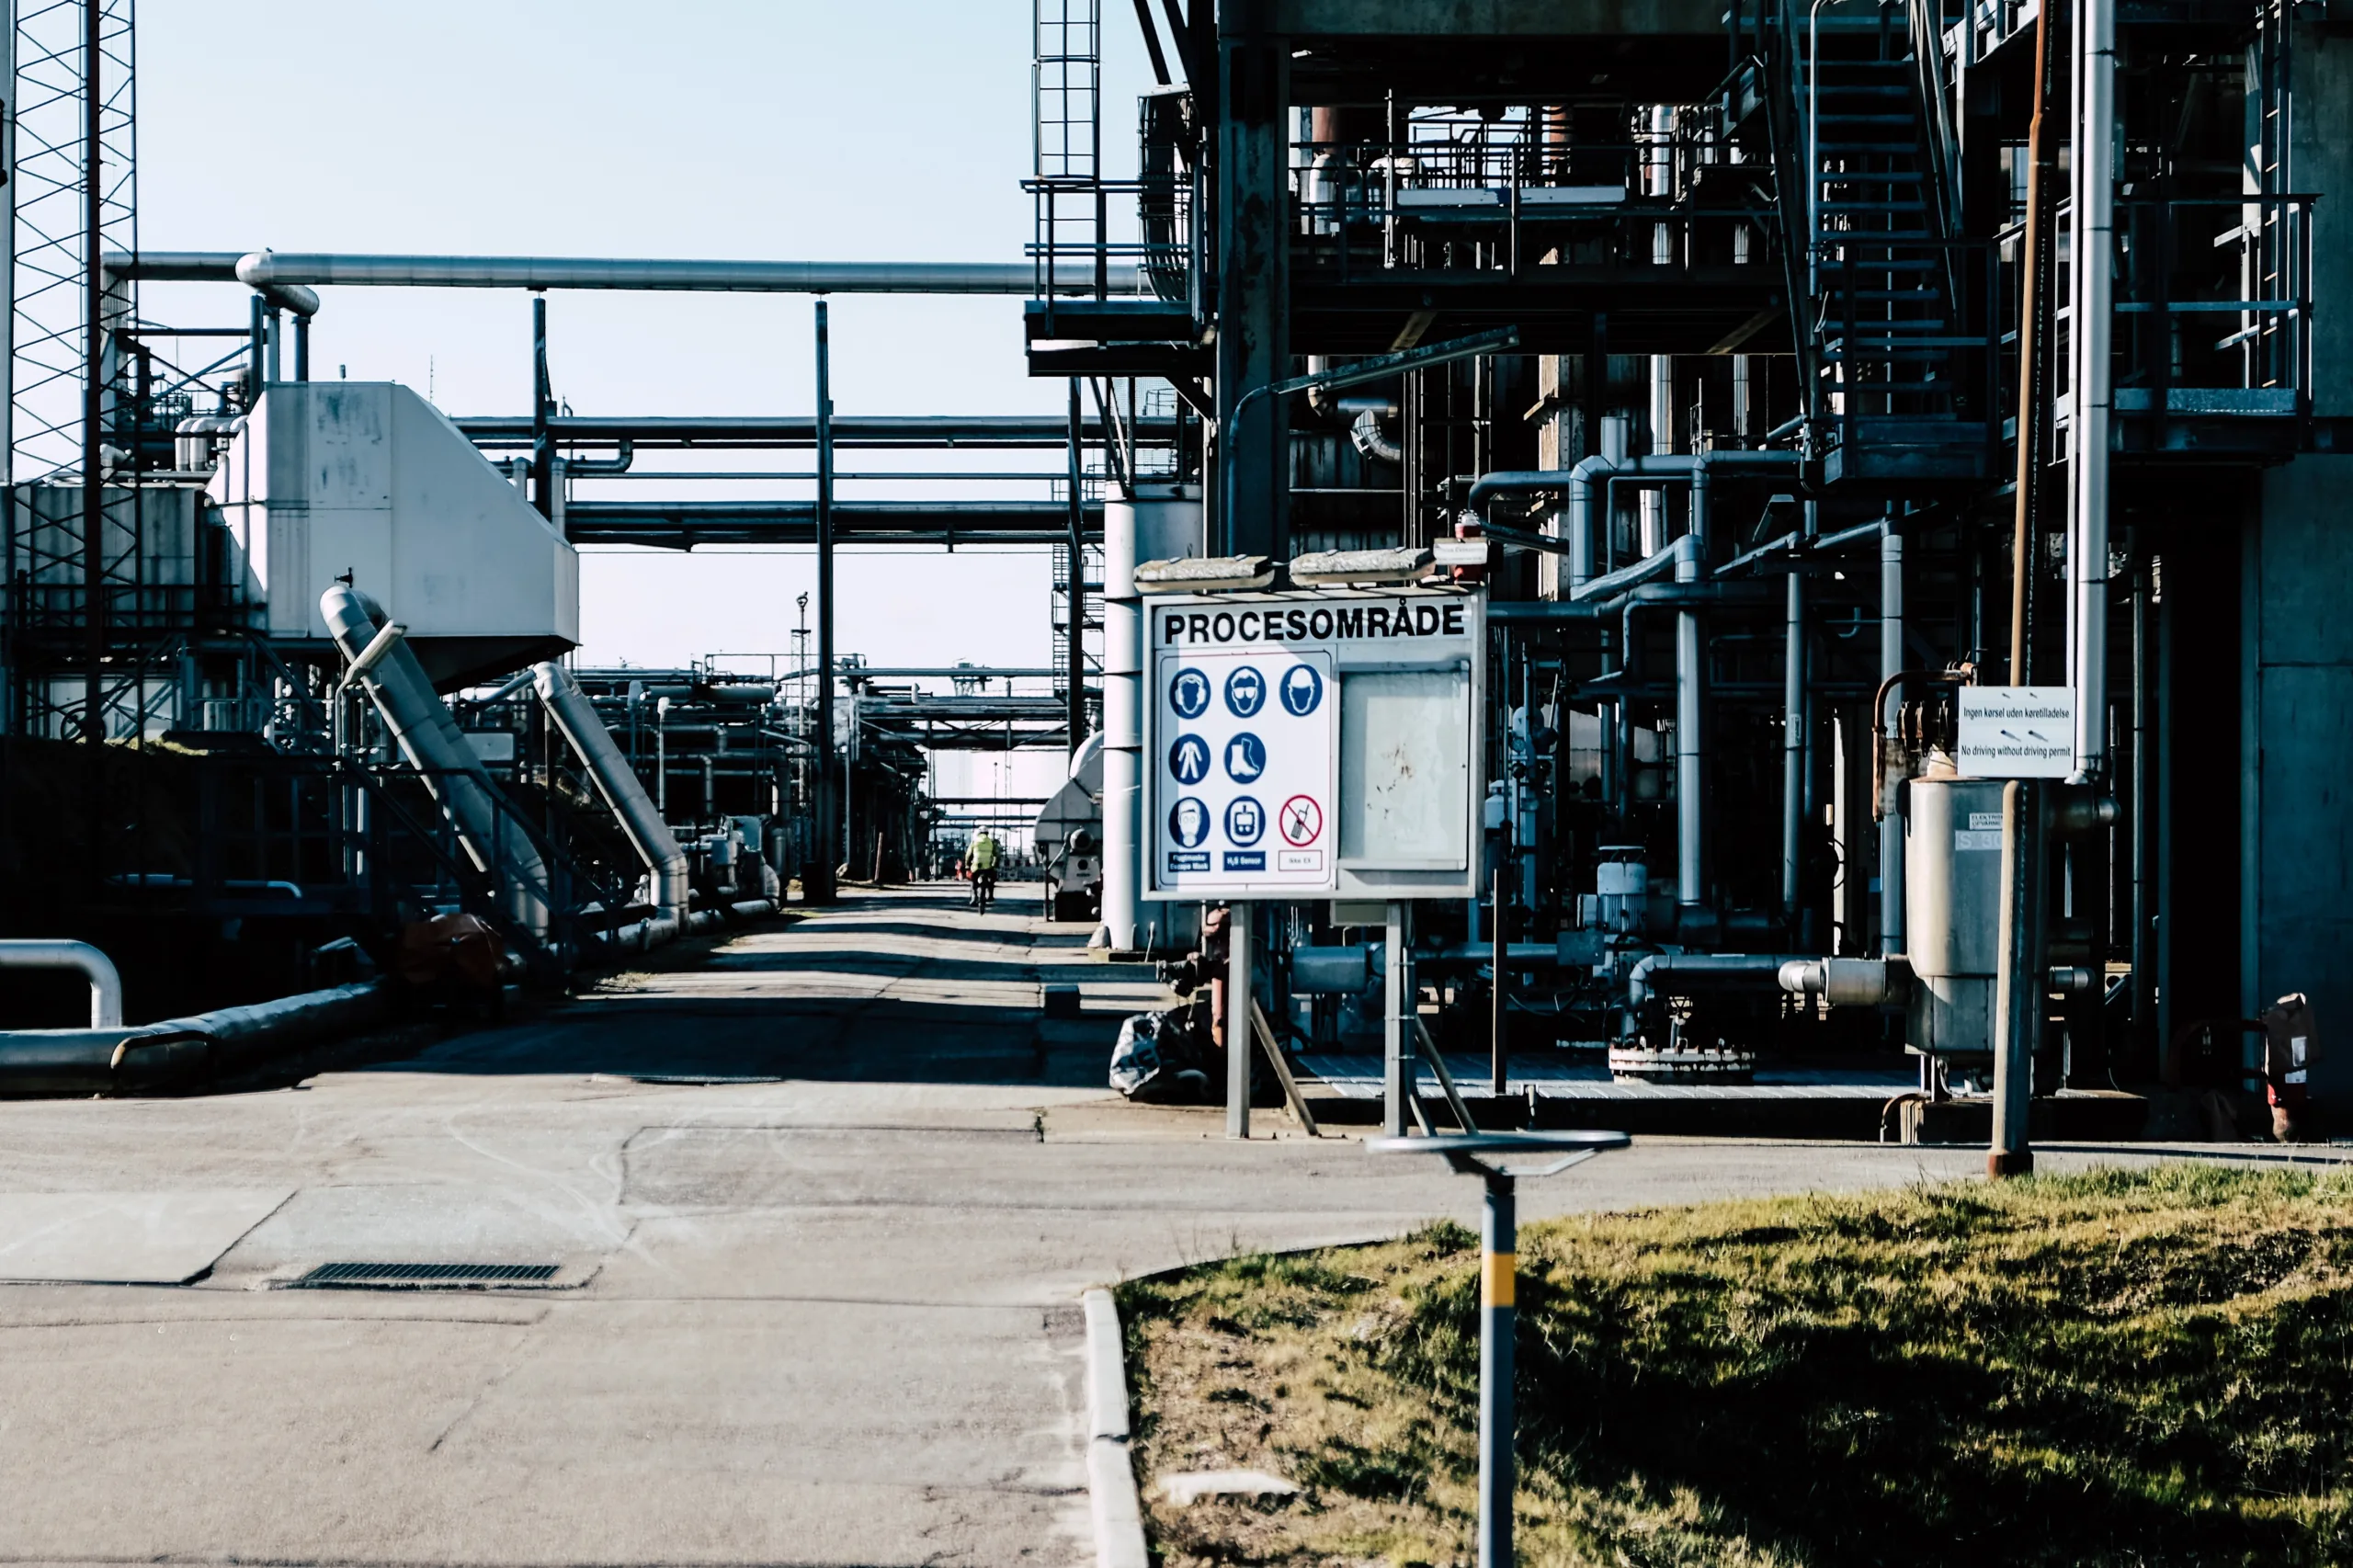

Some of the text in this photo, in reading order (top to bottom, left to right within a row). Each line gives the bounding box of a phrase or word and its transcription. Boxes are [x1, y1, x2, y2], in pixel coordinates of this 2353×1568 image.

[1165, 597, 1464, 644] PROCESOMRÅDE
[1963, 706, 1983, 721] Ingen
[1984, 706, 2005, 719] kørsel
[2006, 707, 2023, 718] uden
[1961, 744, 2071, 759] No driving without driving permit
